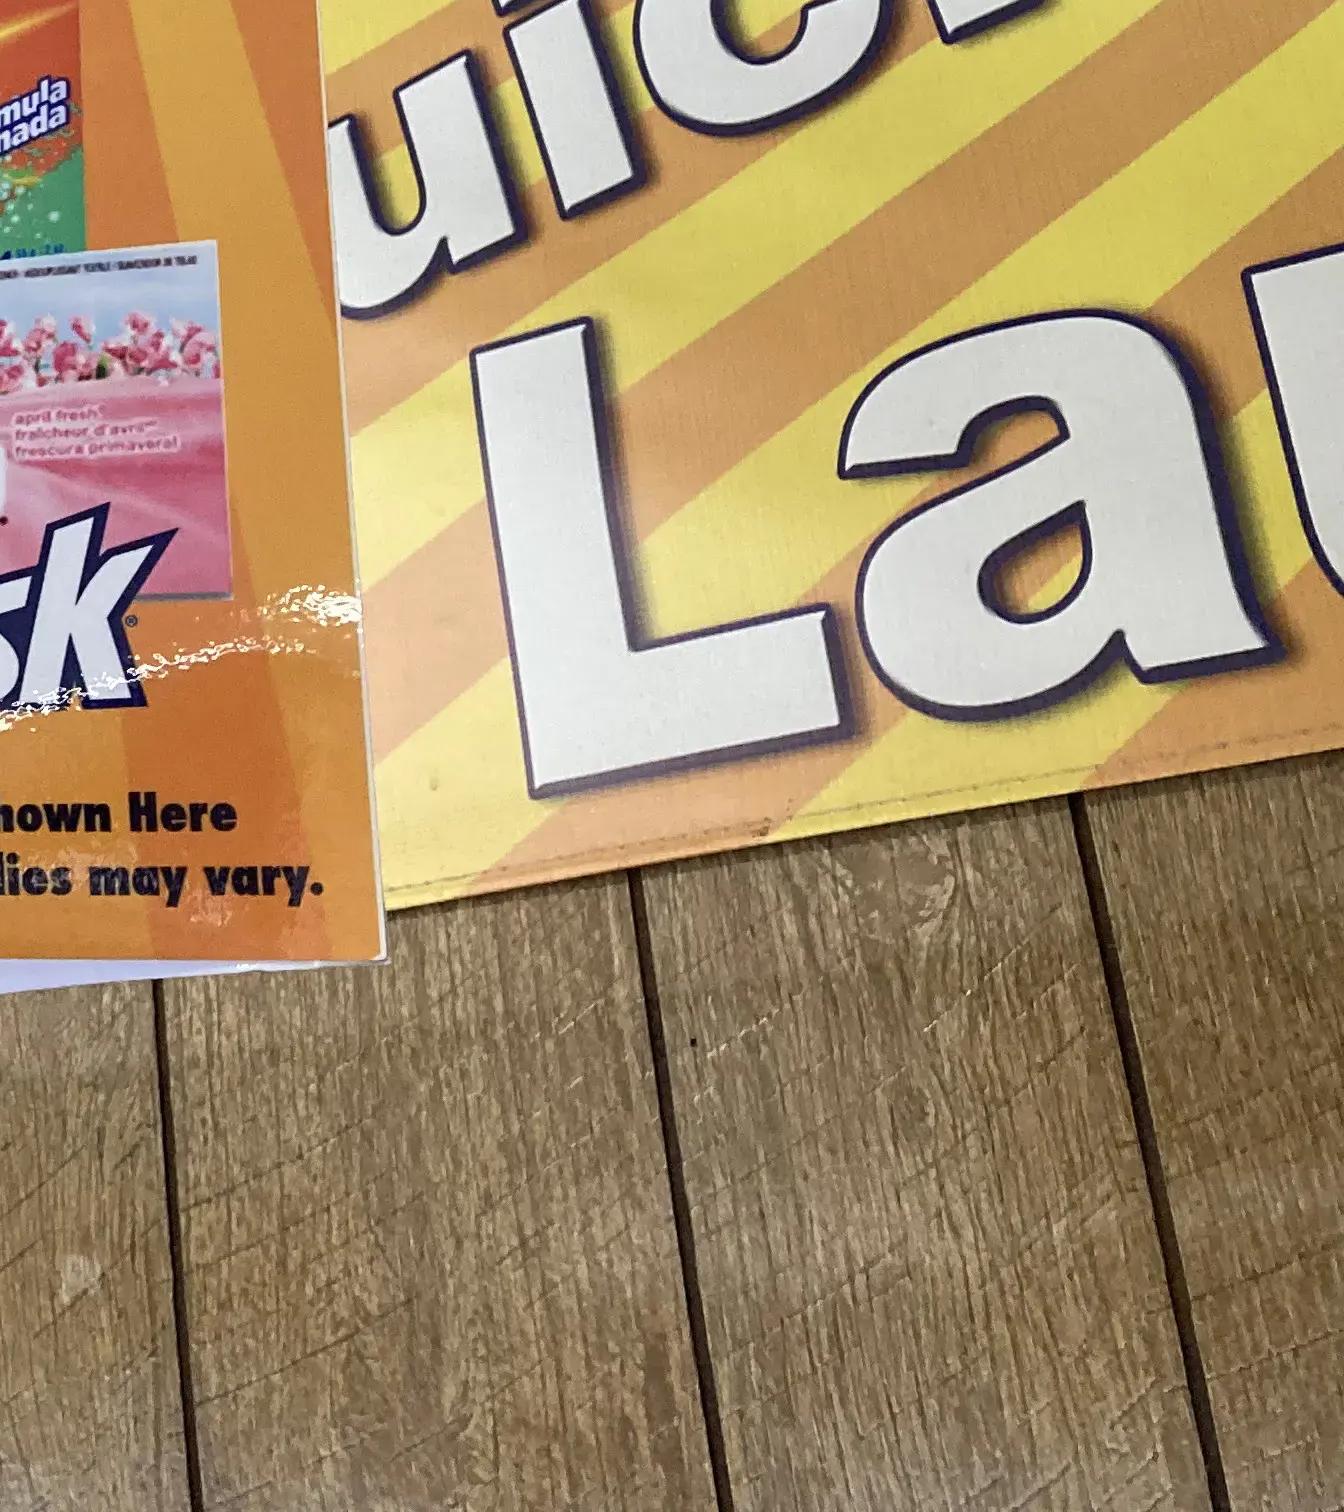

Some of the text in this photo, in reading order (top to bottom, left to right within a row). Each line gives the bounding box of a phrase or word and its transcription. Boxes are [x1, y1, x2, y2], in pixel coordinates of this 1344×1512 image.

[128, 791, 238, 833] Here
[89, 865, 188, 908] may
[203, 865, 324, 908] vary.
